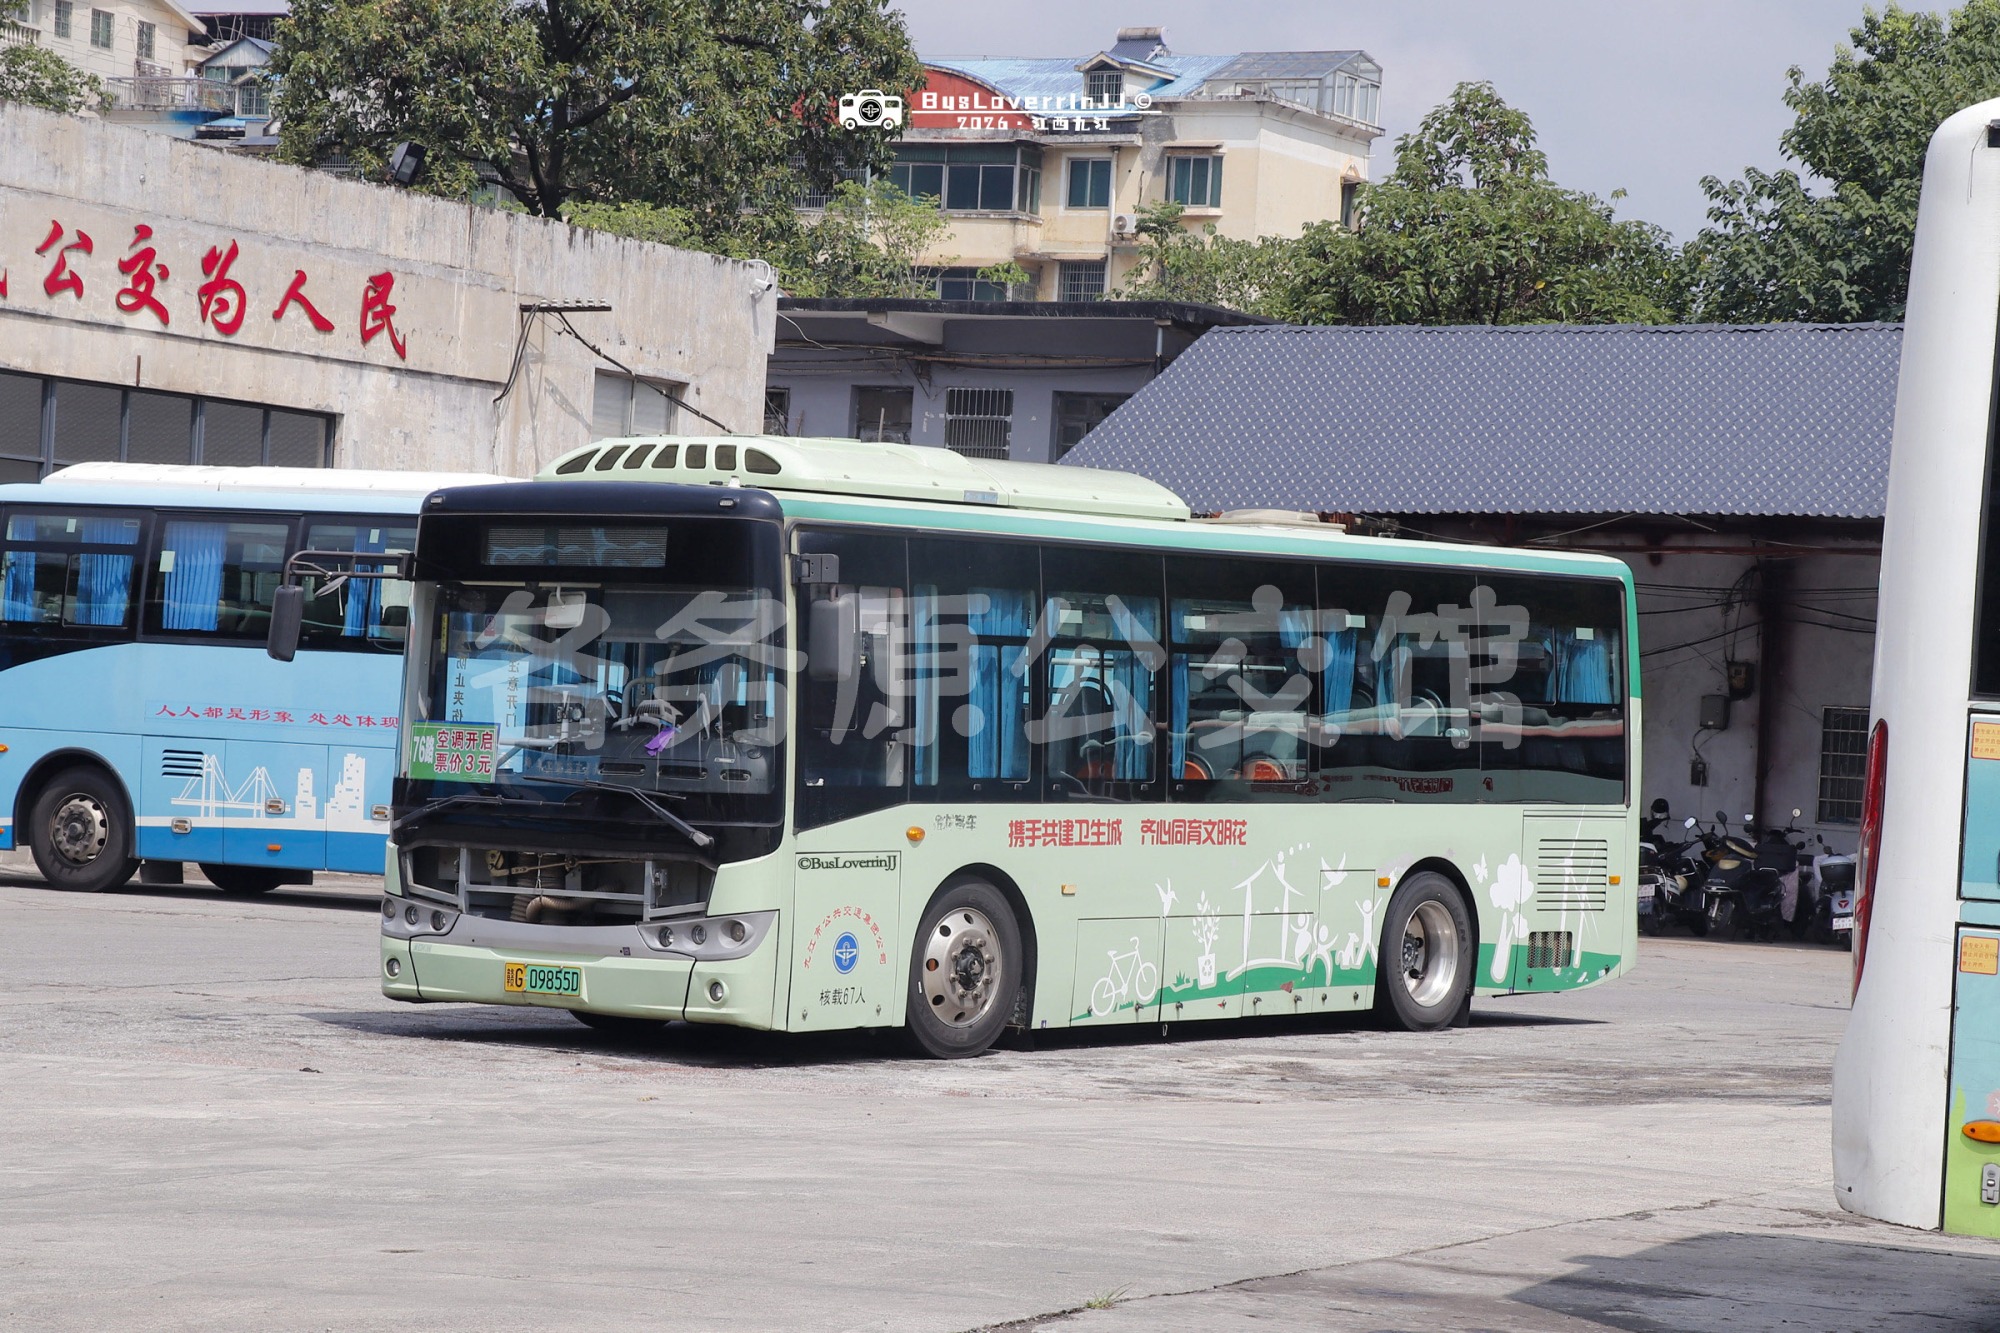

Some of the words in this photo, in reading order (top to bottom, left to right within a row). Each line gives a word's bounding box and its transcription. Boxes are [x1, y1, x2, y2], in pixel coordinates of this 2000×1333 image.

[0, 220, 406, 360] 公交为人民
[156, 704, 294, 723] 人人都是形象
[308, 712, 399, 729] 处处体现
[436, 730, 494, 752] 空调开启
[434, 752, 493, 774] 票价3元
[1009, 818, 1122, 847] 携手共建卫生城
[1141, 818, 1247, 846] 齐心同育文明花
[820, 986, 866, 1006] 核载67人
